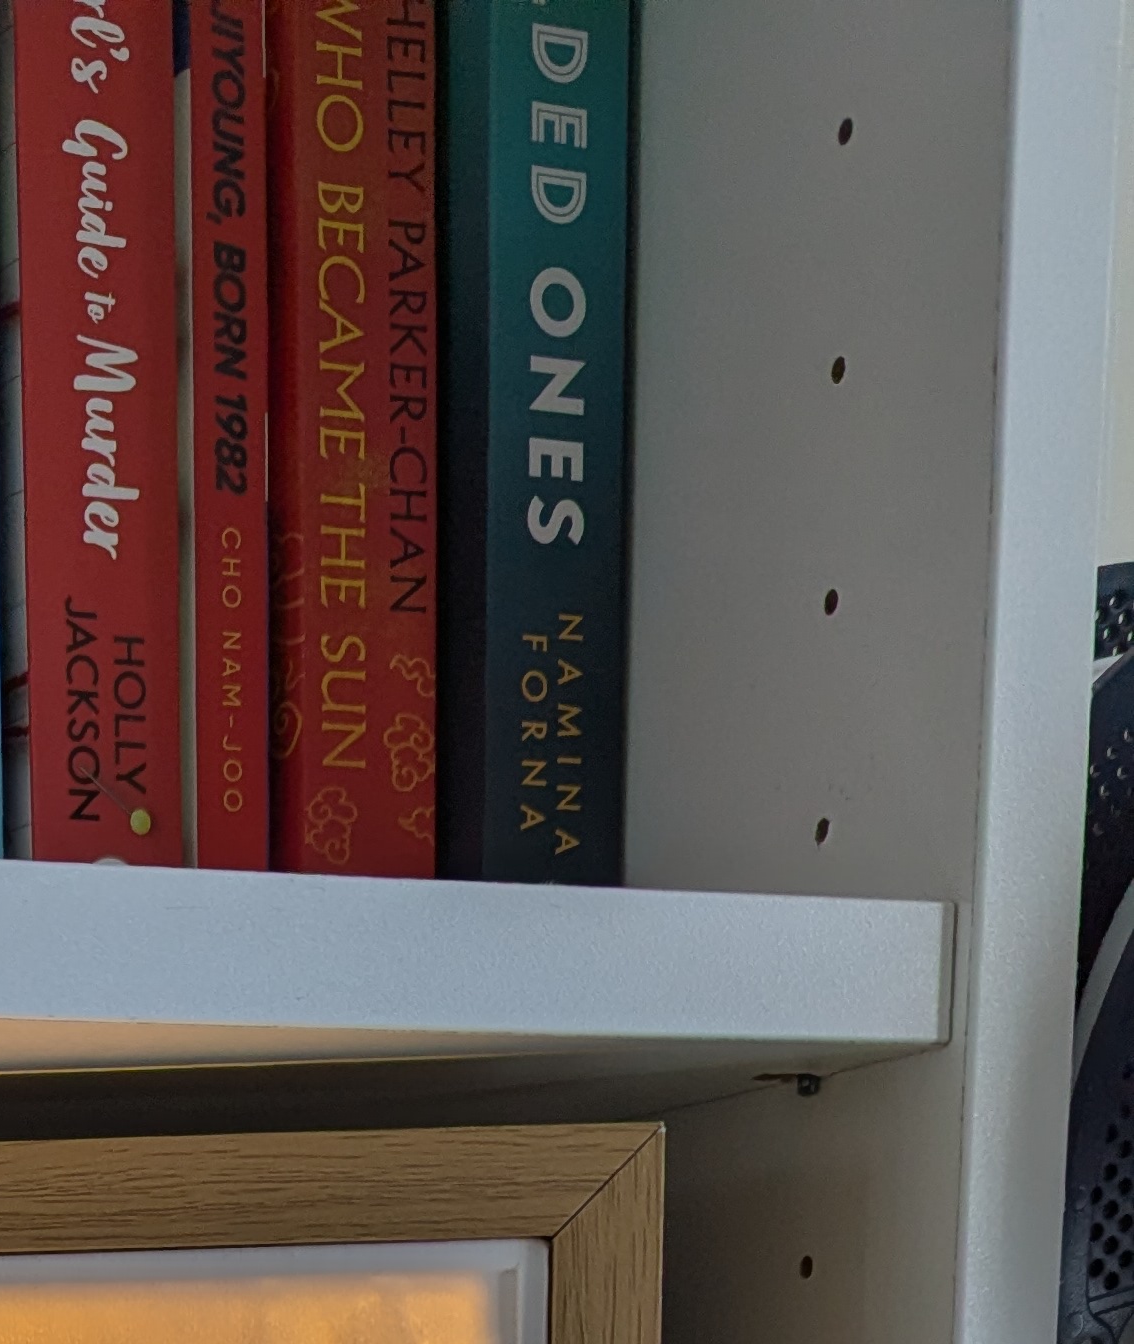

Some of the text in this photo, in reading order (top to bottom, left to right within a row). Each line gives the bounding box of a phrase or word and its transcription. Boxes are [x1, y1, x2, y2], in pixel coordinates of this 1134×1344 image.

[61, 118, 129, 279] Guide
[83, 291, 117, 325] to
[212, 240, 248, 381] BORN
[527, 0, 589, 546] DED ONES
[72, 335, 141, 560] Murder
[212, 391, 249, 496] 1982
[314, 0, 367, 770] WHO BECAME THE SUN
[386, 218, 428, 614] PARKER-CHAN
[64, 595, 101, 822] JACKSON
[112, 634, 147, 796] HOLLY
[221, 527, 244, 812] CHO NAM-JOO
[519, 633, 549, 831] FORNA
[555, 612, 585, 856] NAMINA
